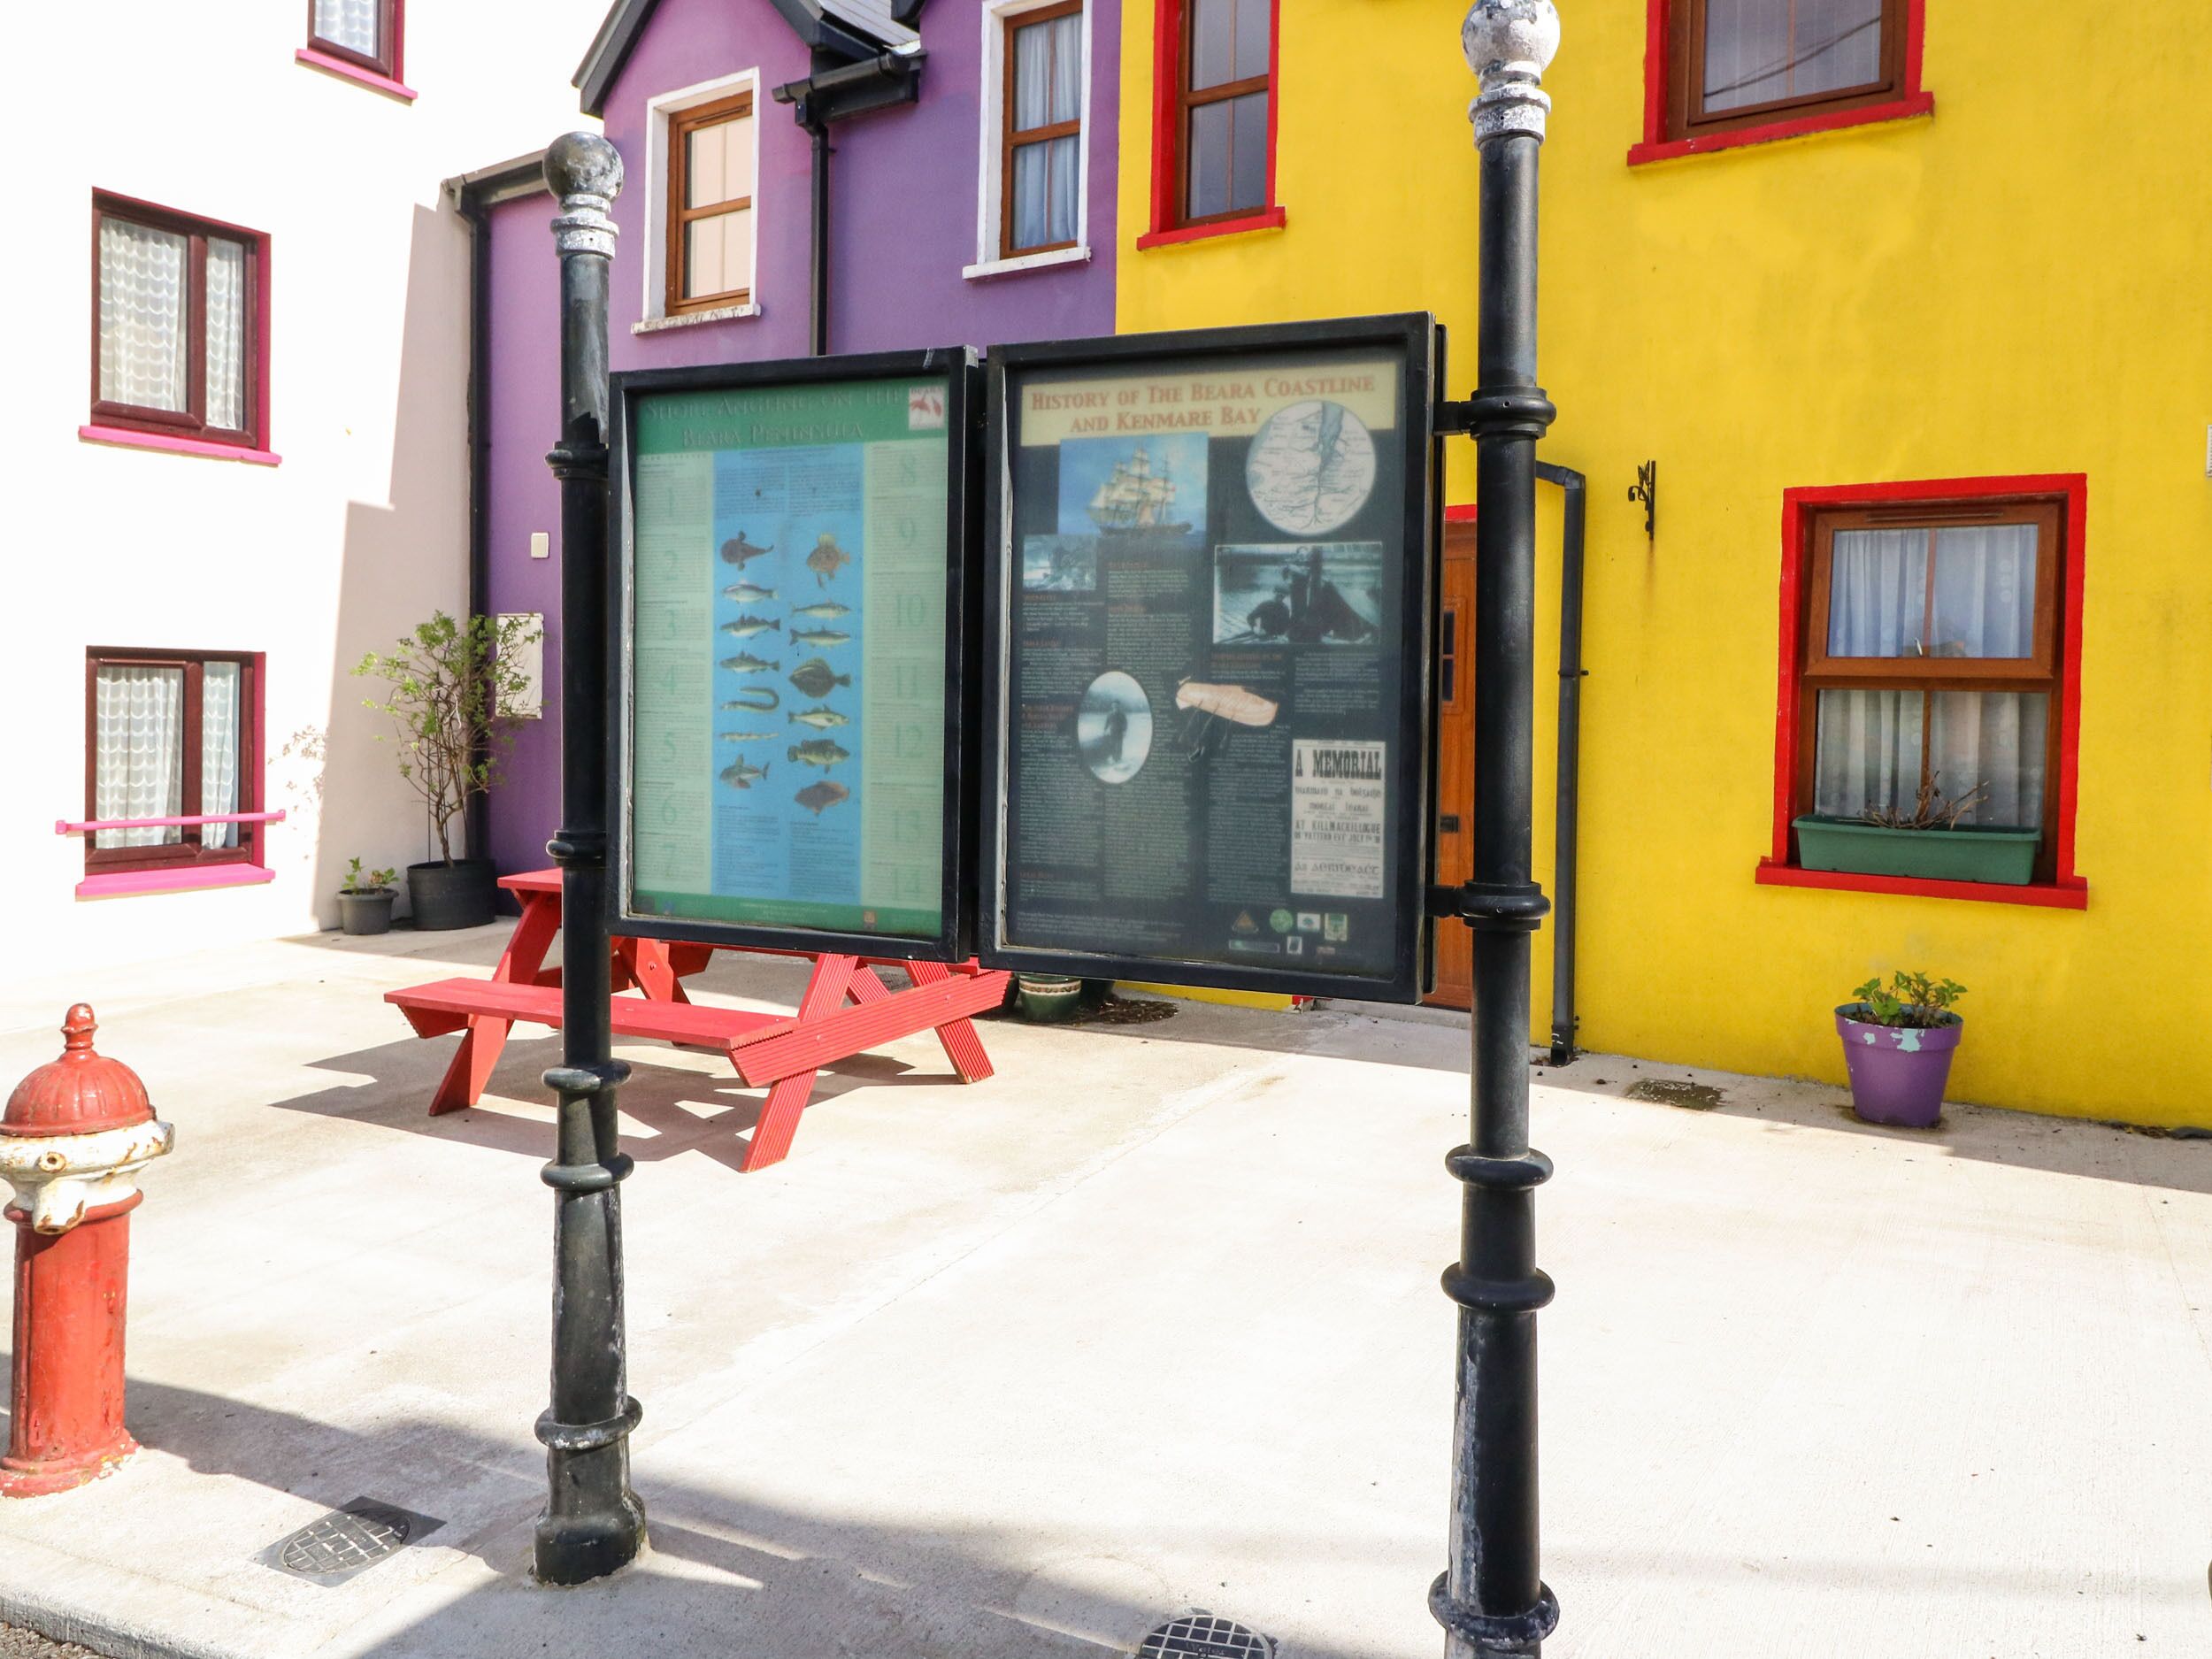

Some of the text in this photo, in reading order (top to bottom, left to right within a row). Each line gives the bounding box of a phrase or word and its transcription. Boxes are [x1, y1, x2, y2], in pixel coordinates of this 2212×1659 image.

[1032, 376, 1376, 411] HISTORY OF THE BEARA COASTLINE
[1071, 405, 1261, 433] AND KENMARE BAY
[1294, 749, 1382, 780] A MEMORIAL
